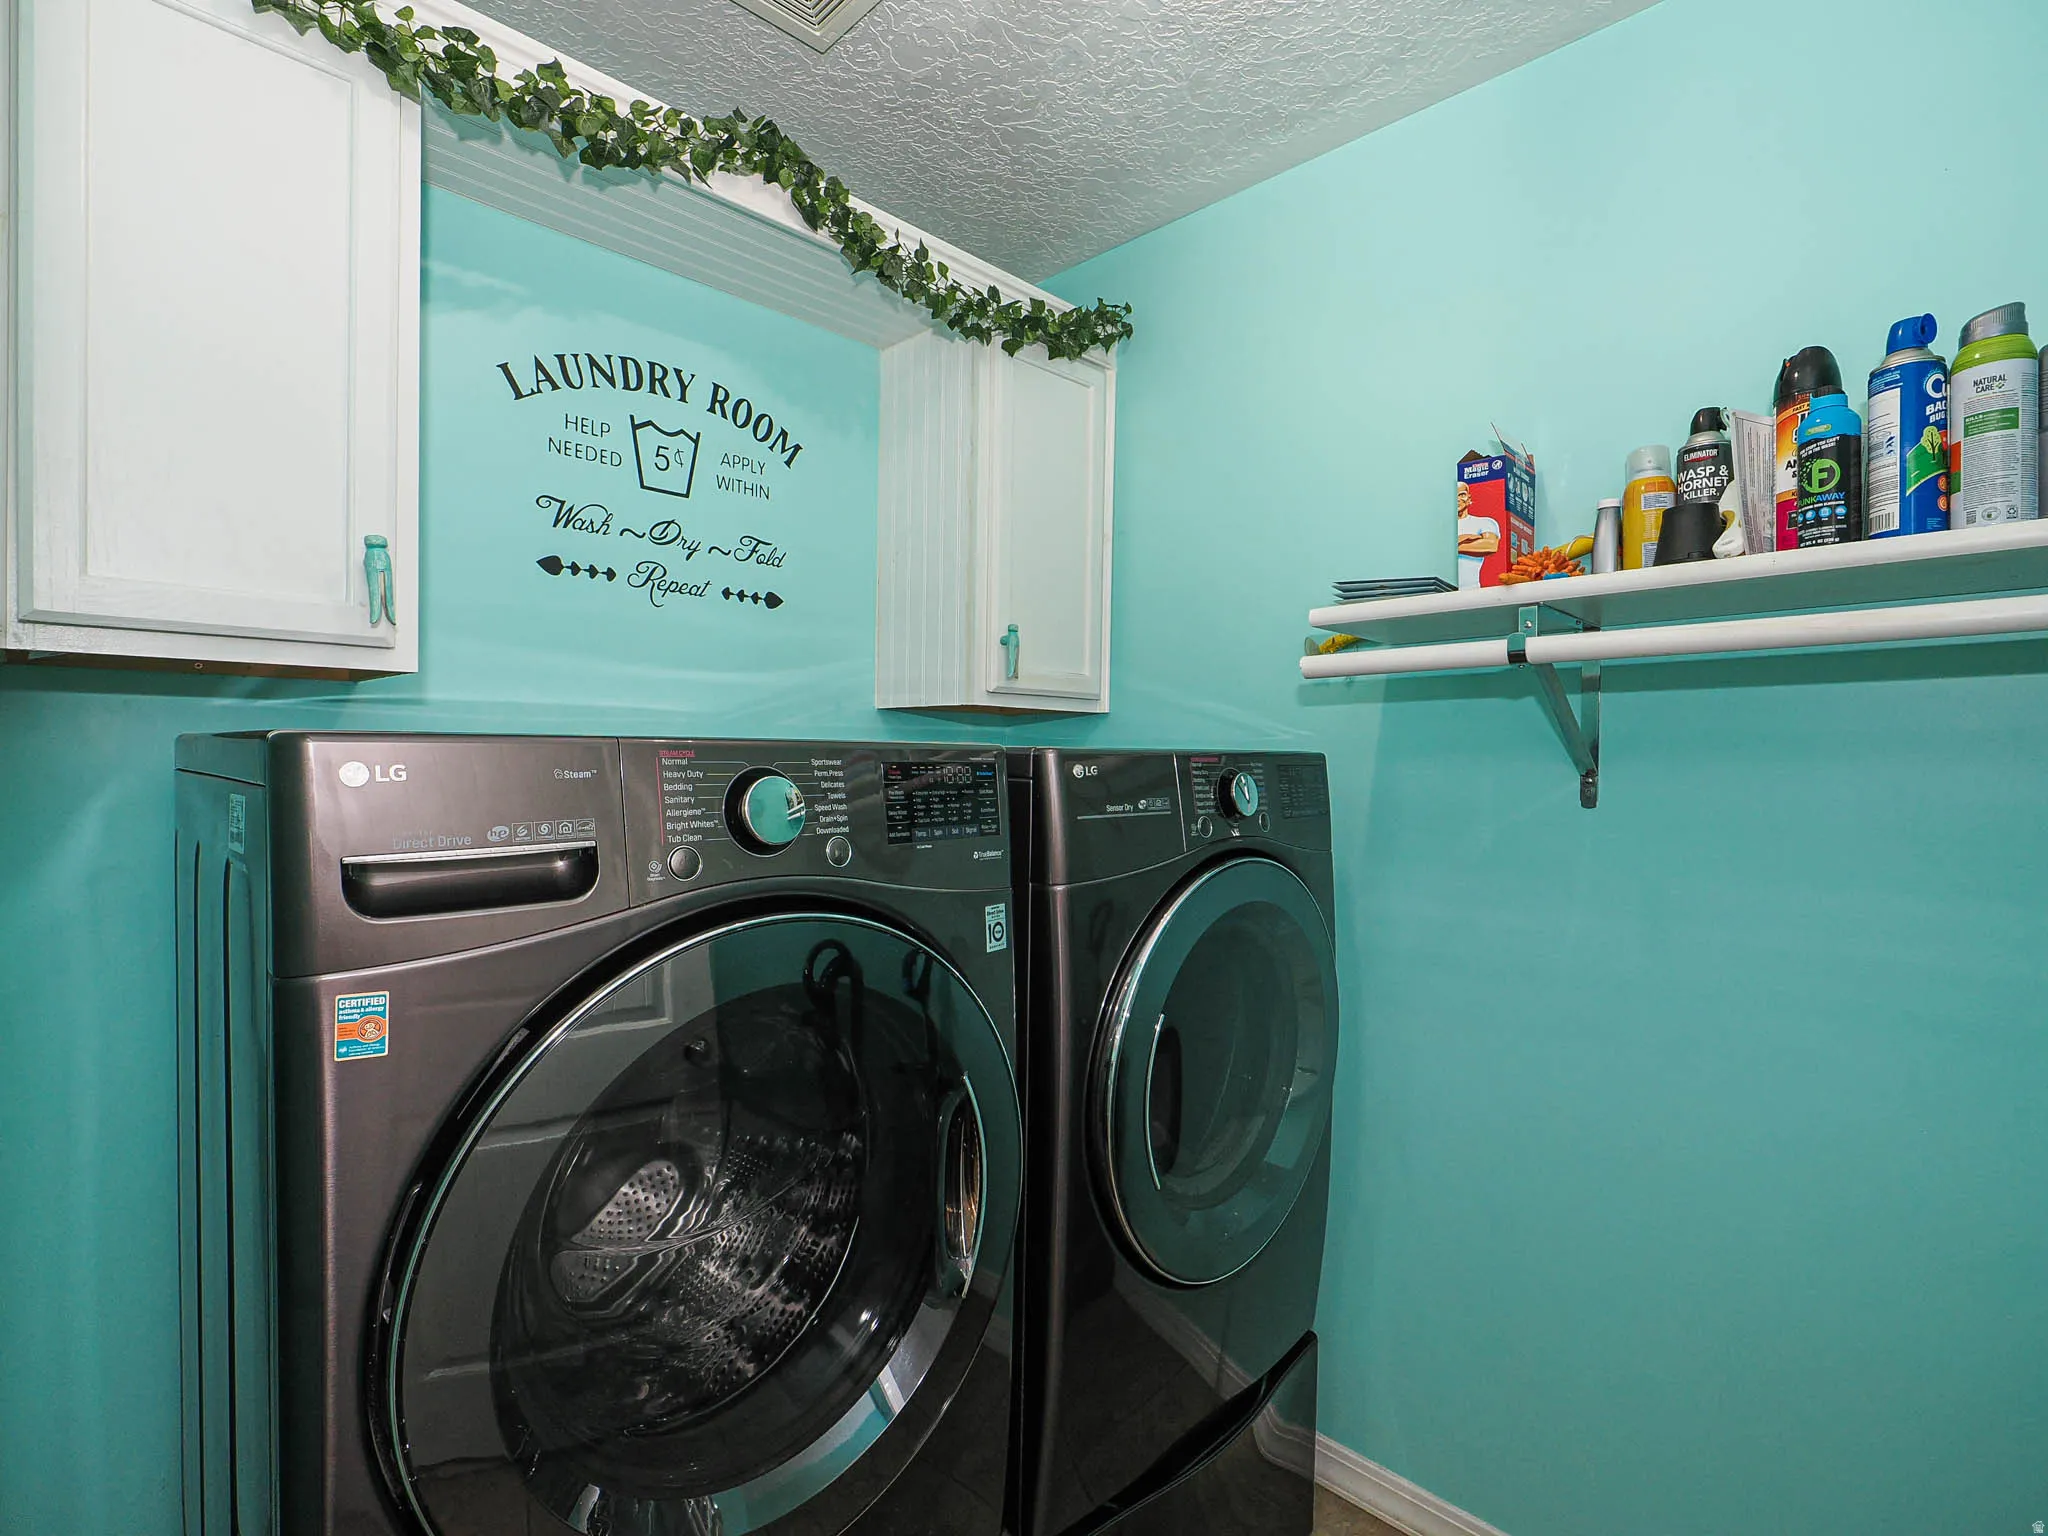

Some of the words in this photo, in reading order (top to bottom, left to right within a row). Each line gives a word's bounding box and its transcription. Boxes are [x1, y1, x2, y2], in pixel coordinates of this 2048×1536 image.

[1973, 374, 2008, 387] NATURAL
[1976, 385, 1994, 393] CARE
[496, 353, 696, 403] LAUNDRY
[706, 382, 803, 469] ROOM
[565, 413, 611, 438] HELP
[548, 437, 623, 467] NEEDED
[1684, 449, 1718, 461] ELIMINATOR
[720, 453, 766, 476] APPLY
[1464, 464, 1488, 473] Magic
[1464, 471, 1488, 479] Eraser
[1678, 466, 1715, 484] WASP
[1719, 465, 1728, 476] &
[716, 474, 771, 501] WITHIN
[1678, 477, 1728, 494] HORNET
[536, 494, 614, 536] Wash
[648, 519, 701, 561] Dry
[734, 535, 787, 568] Fold
[627, 561, 713, 608] Repeat
[662, 758, 687, 766] Normal
[375, 764, 408, 782] LG
[663, 771, 685, 779] Heavy
[687, 770, 704, 778] Duty
[1085, 766, 1098, 776] LG
[663, 784, 692, 792] Bedding
[664, 796, 695, 804] Sanitary
[814, 804, 831, 812] Speed
[1106, 804, 1124, 812] Sensor
[1125, 804, 1133, 812] Dry
[820, 814, 848, 822] Drain+Spin
[666, 822, 689, 831] Bright
[816, 826, 849, 834] Downloaded
[393, 837, 434, 849] Direct
[438, 835, 472, 847] Drive
[667, 835, 681, 843] Tub
[339, 997, 385, 1008] CERTIFIED
